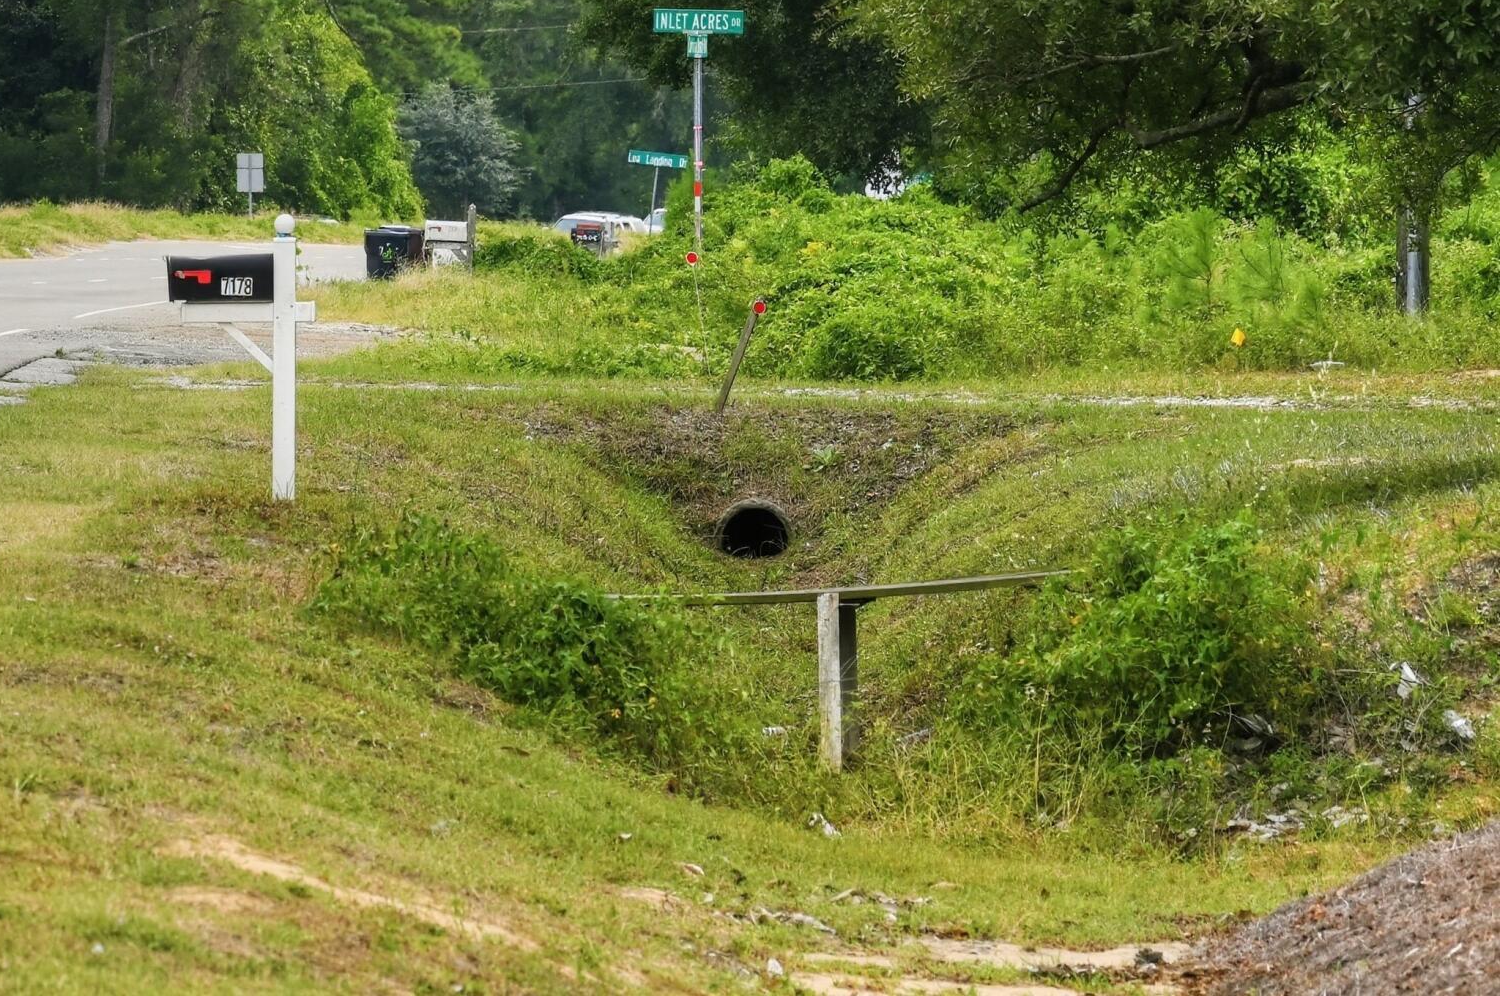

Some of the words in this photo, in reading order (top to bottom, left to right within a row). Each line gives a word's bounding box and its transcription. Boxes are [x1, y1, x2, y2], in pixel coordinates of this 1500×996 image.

[655, 13, 689, 29] INLET
[692, 13, 729, 30] ACRES
[731, 17, 740, 27] DR
[221, 277, 253, 295] 7178
